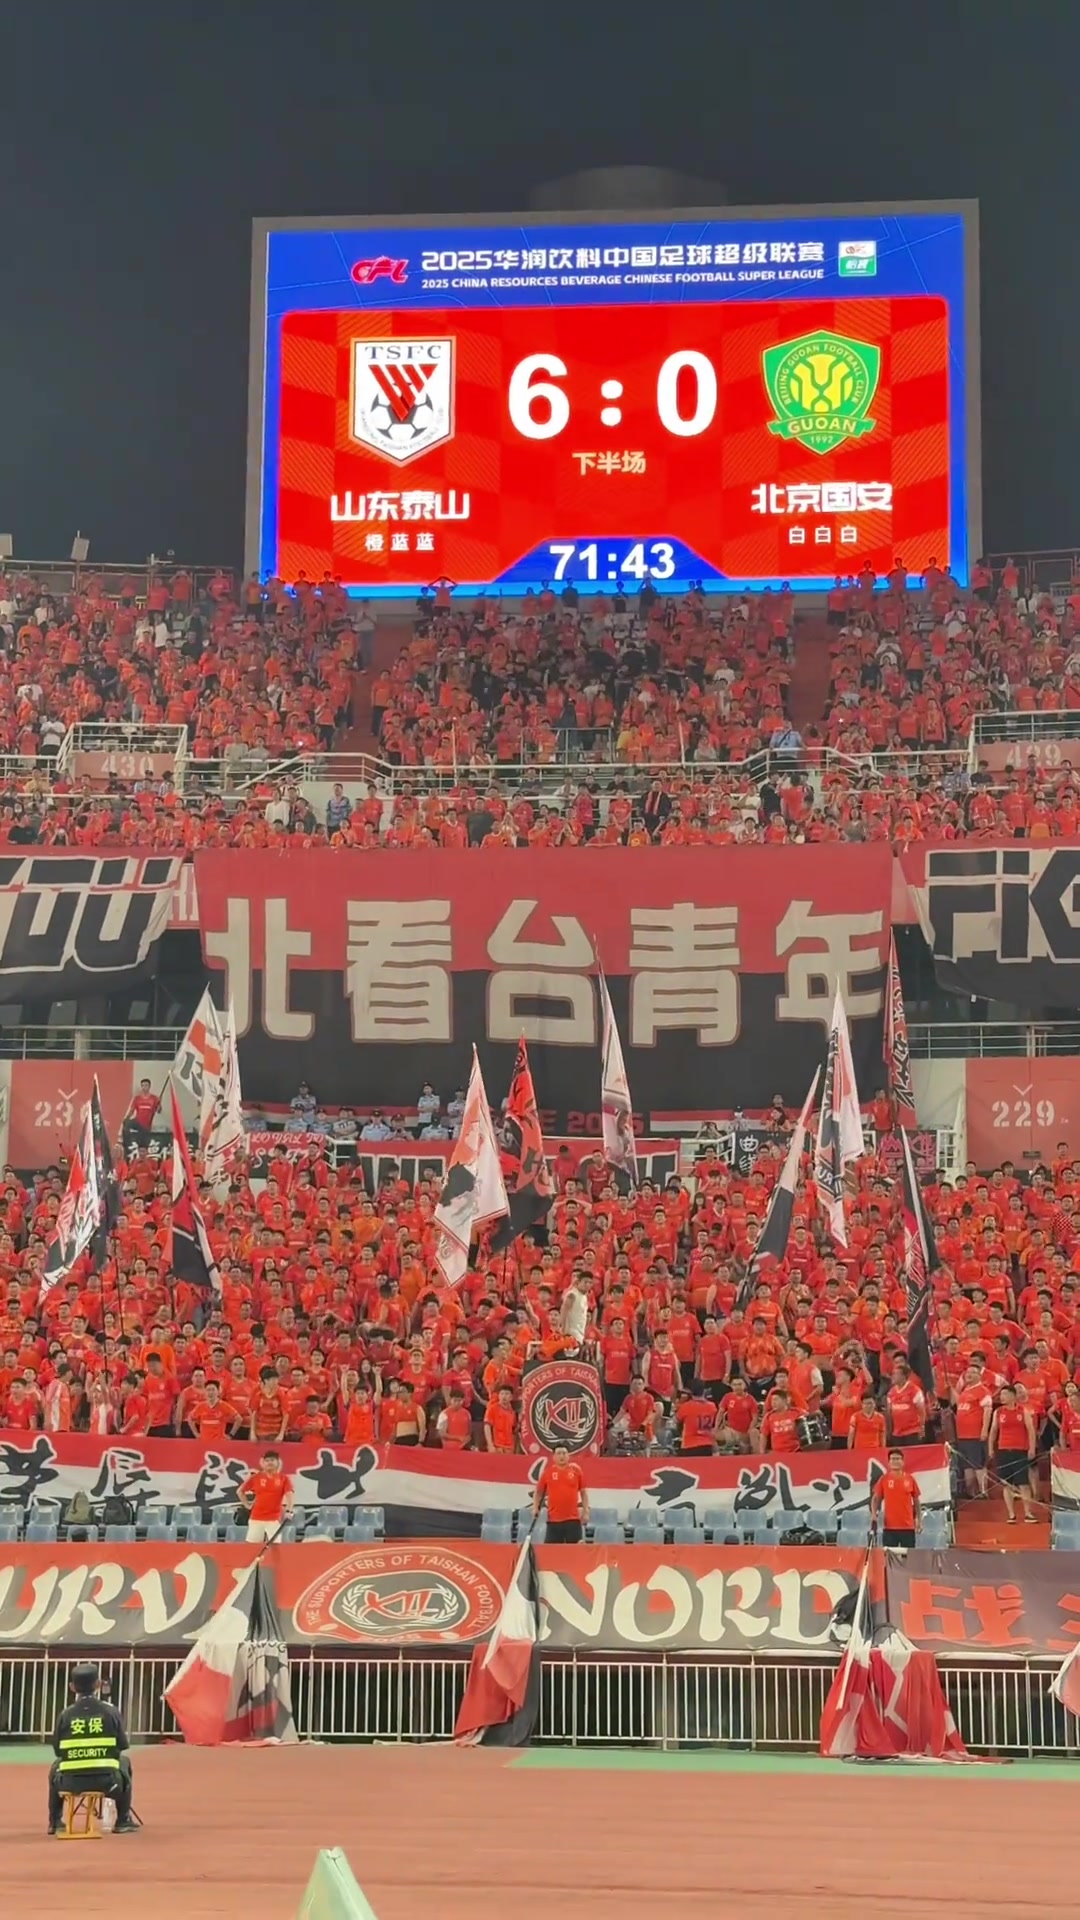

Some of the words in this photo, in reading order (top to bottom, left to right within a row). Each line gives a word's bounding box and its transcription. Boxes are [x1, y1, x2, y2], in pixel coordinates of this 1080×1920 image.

[421, 242, 825, 271] 2025华润饮料中国足球超级联赛
[422, 278, 449, 289] 2025
[452, 277, 488, 288] CHINA
[491, 276, 558, 287] RESOURCES
[561, 274, 621, 286] BEVERAGE
[624, 273, 673, 284] CHINESE
[675, 272, 736, 283] FOOTBALL
[738, 270, 776, 281] SUPER
[778, 269, 824, 280] LEAGUE
[365, 345, 442, 360] TSFC
[787, 344, 820, 367] GUOAN
[823, 343, 863, 376] FOOTBALL
[508, 353, 570, 440] 6
[657, 349, 718, 437] 0
[788, 417, 858, 433] GUOAN
[810, 435, 834, 444] 1992
[572, 450, 647, 476] 下半场
[331, 489, 470, 522] 山东泰山
[750, 481, 893, 514] 北京国安
[549, 542, 676, 580] 71:43
[100, 755, 154, 777] 430
[205, 898, 884, 1047] 北看台青年
[991, 1100, 1055, 1127] 229
[308, 1557, 386, 1615] SUPPORTERS
[391, 1554, 414, 1566] OF
[419, 1554, 481, 1586] TAISHAN
[474, 1584, 494, 1630] FOOTBALL
[538, 1564, 853, 1645] NORD
[70, 1717, 103, 1735] 安保
[67, 1747, 108, 1759] SECURITY
